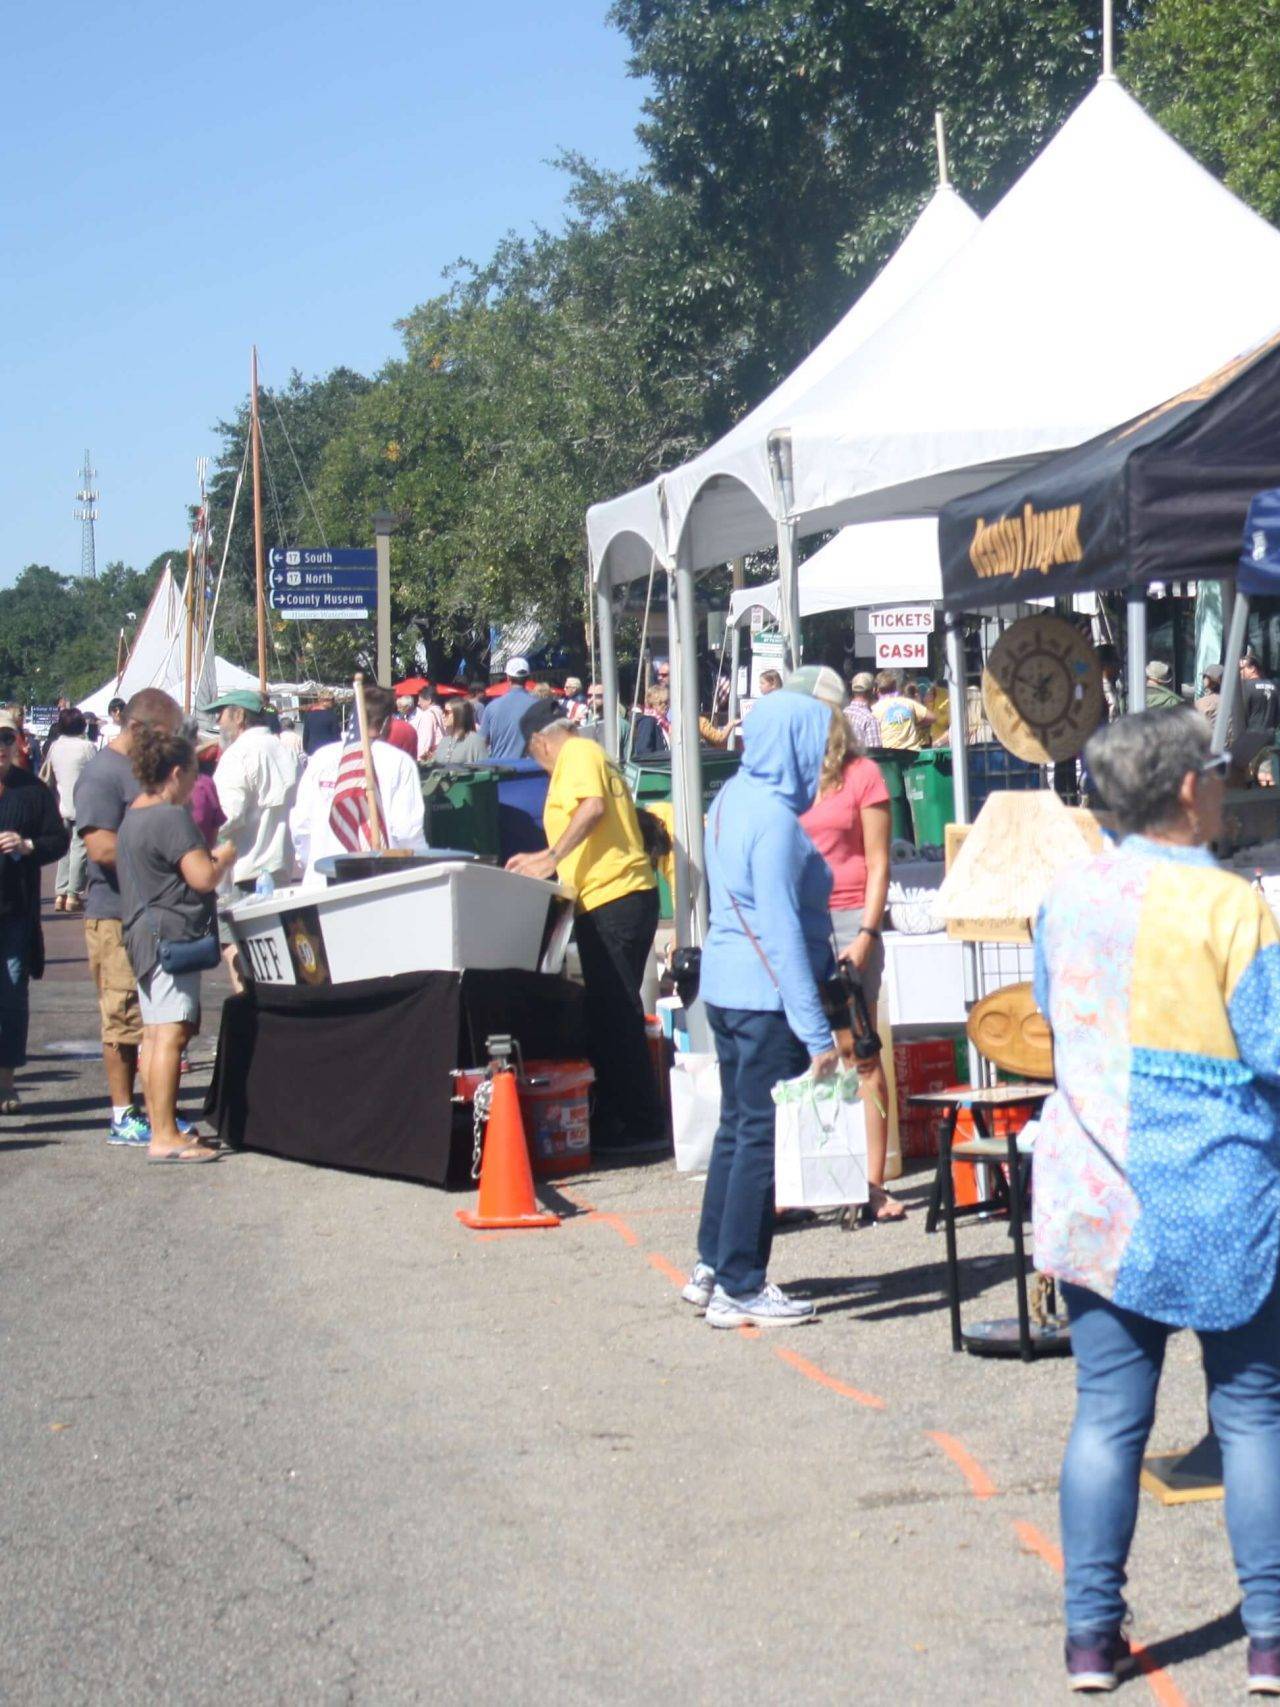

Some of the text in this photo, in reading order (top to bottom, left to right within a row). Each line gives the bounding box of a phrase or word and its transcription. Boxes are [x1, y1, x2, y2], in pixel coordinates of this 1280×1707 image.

[304, 552, 333, 564] South
[305, 572, 333, 584] North
[286, 594, 363, 606] County Museum
[871, 613, 932, 628] TICKETS
[879, 643, 925, 658] CASH
